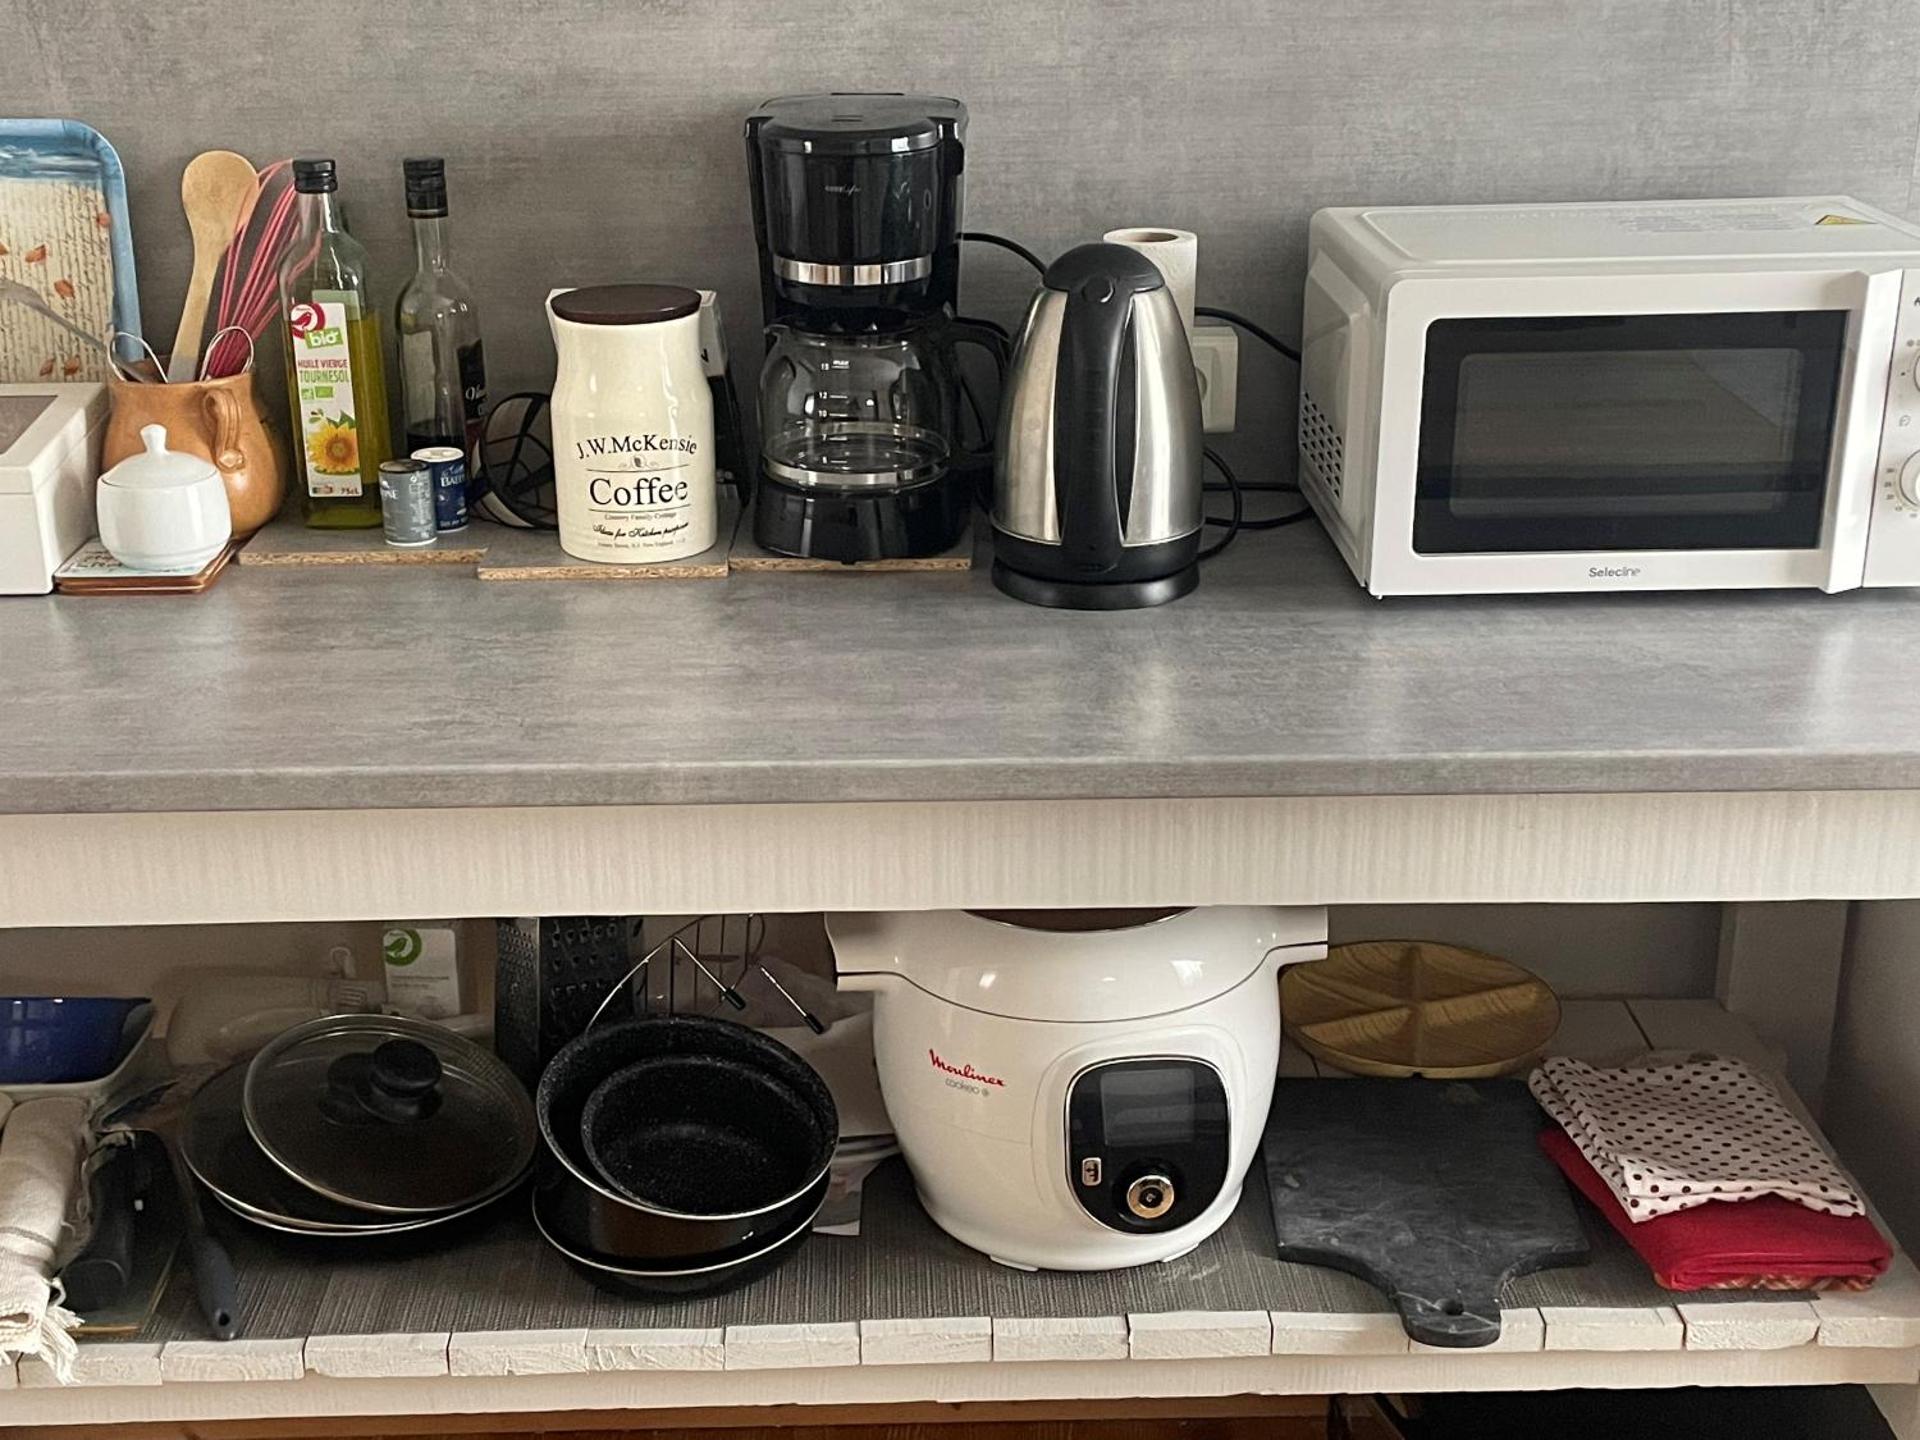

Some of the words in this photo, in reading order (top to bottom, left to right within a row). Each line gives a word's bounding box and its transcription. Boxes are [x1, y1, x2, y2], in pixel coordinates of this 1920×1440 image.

[310, 329, 339, 346] bio
[300, 370, 349, 383] TOURNESOL
[589, 476, 688, 506] Coffee
[929, 1048, 1005, 1087] Moulinex
